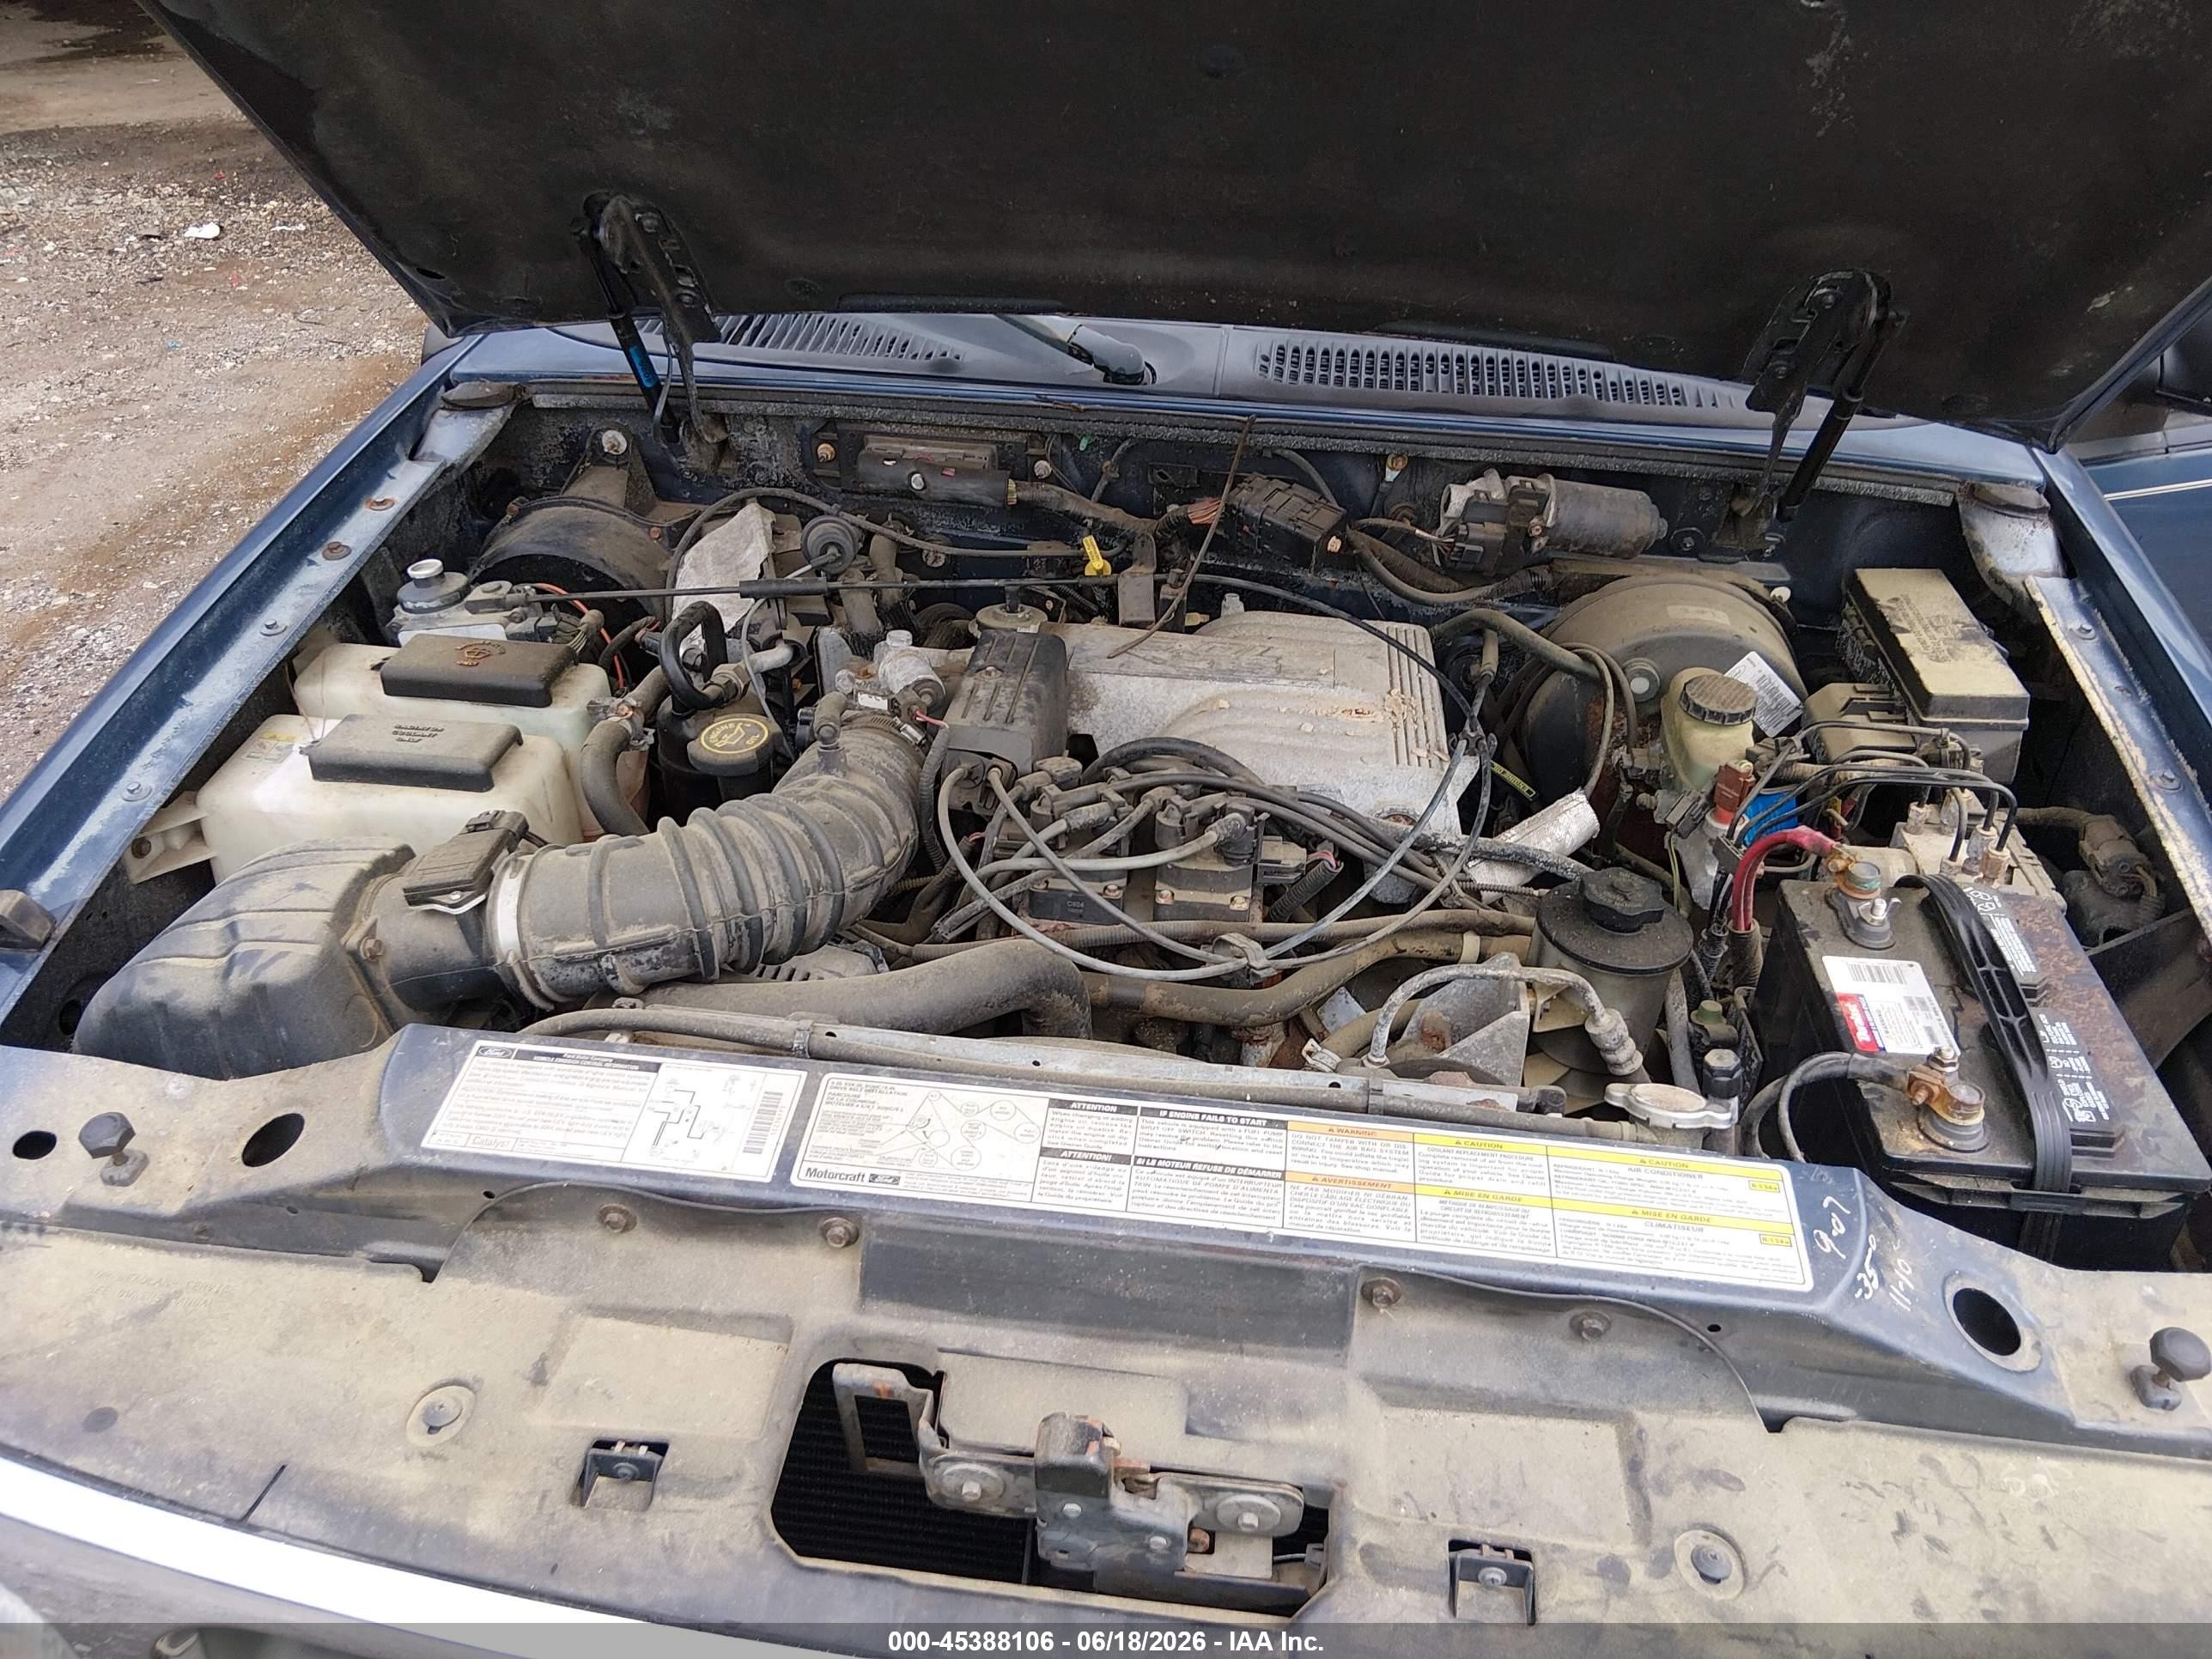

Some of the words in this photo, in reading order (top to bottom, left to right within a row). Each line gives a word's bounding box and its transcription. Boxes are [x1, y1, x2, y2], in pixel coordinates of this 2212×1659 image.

[709, 722, 735, 743] ENGINE
[746, 734, 759, 744] OIL
[1070, 1102, 1117, 1112] ATTENTION
[1168, 1110, 1200, 1120] ENGINE
[1200, 1114, 1224, 1122] FAILS
[1238, 1117, 1267, 1127] START
[1336, 1127, 1376, 1136] WARNING
[472, 1136, 510, 1148] Catalyst
[1463, 1140, 1504, 1149] CAUTION
[1060, 1150, 1112, 1162] ATTENTION!
[1136, 1156, 1146, 1164] SI
[1146, 1157, 1157, 1166] LE
[1157, 1158, 1191, 1170] MOTEUR
[1192, 1162, 1223, 1172] REFUSE
[1224, 1164, 1235, 1174] DE
[1236, 1166, 1282, 1179] DÉMARRER
[1648, 1159, 1689, 1168] CAUTION
[805, 1166, 866, 1182] Motorcraft
[1321, 1176, 1391, 1188] AVERTISSEMENT
[1492, 1194, 1522, 1202] GARDE
[1680, 1214, 1712, 1223] GARDE
[1644, 1220, 1705, 1232] CLIMATISEUR
